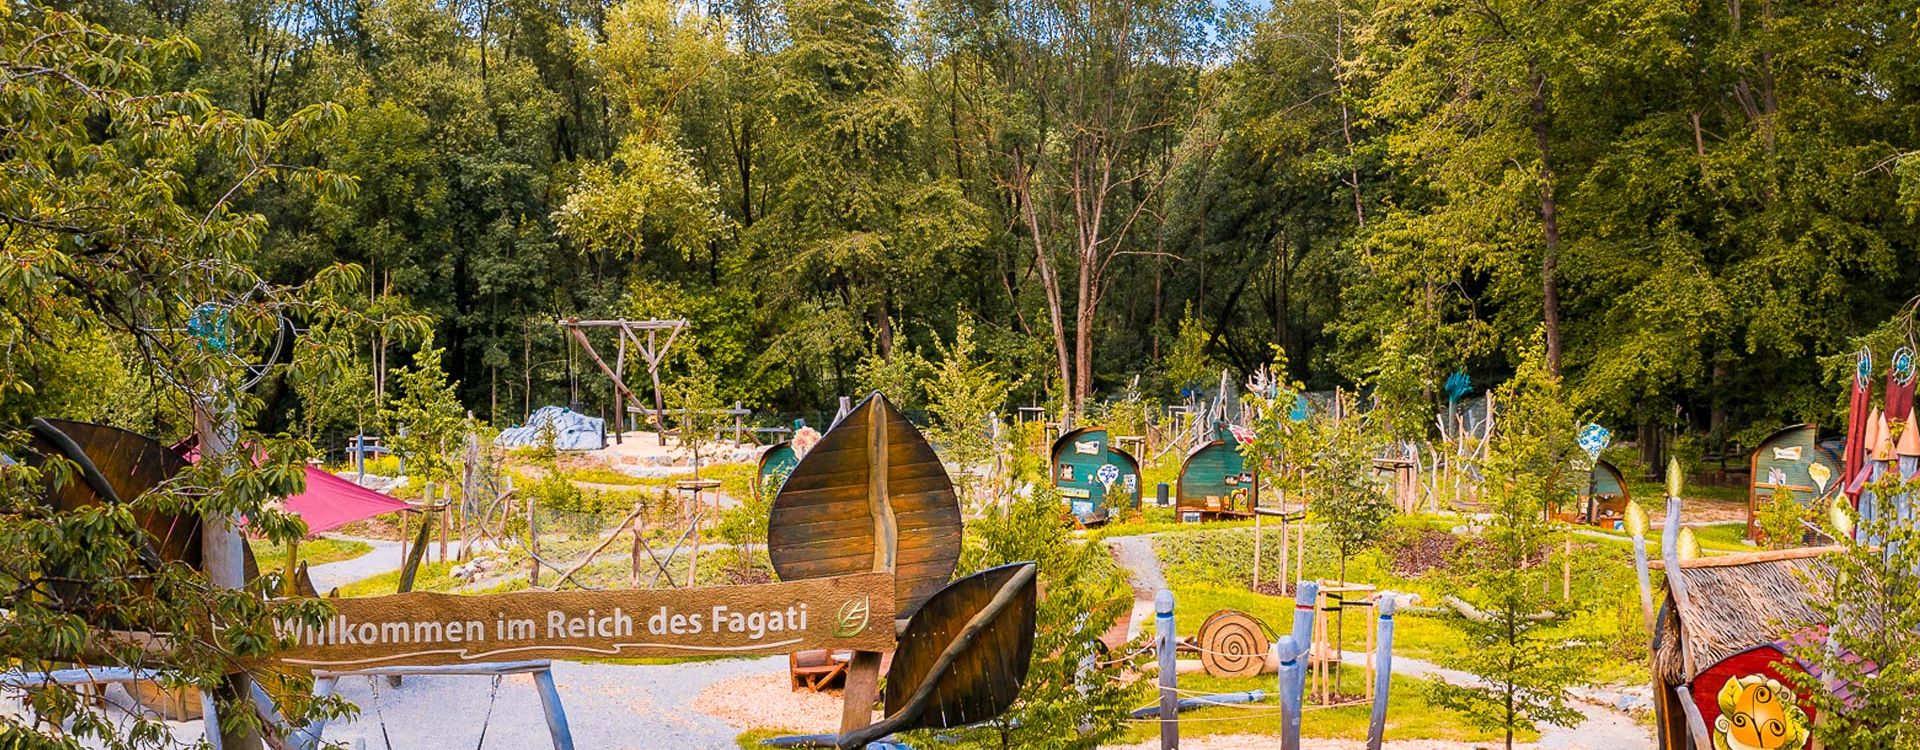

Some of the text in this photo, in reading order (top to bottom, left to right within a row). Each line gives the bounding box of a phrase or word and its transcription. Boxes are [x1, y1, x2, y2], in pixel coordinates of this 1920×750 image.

[272, 603, 808, 646] Willkommen im Reich des Fagati
